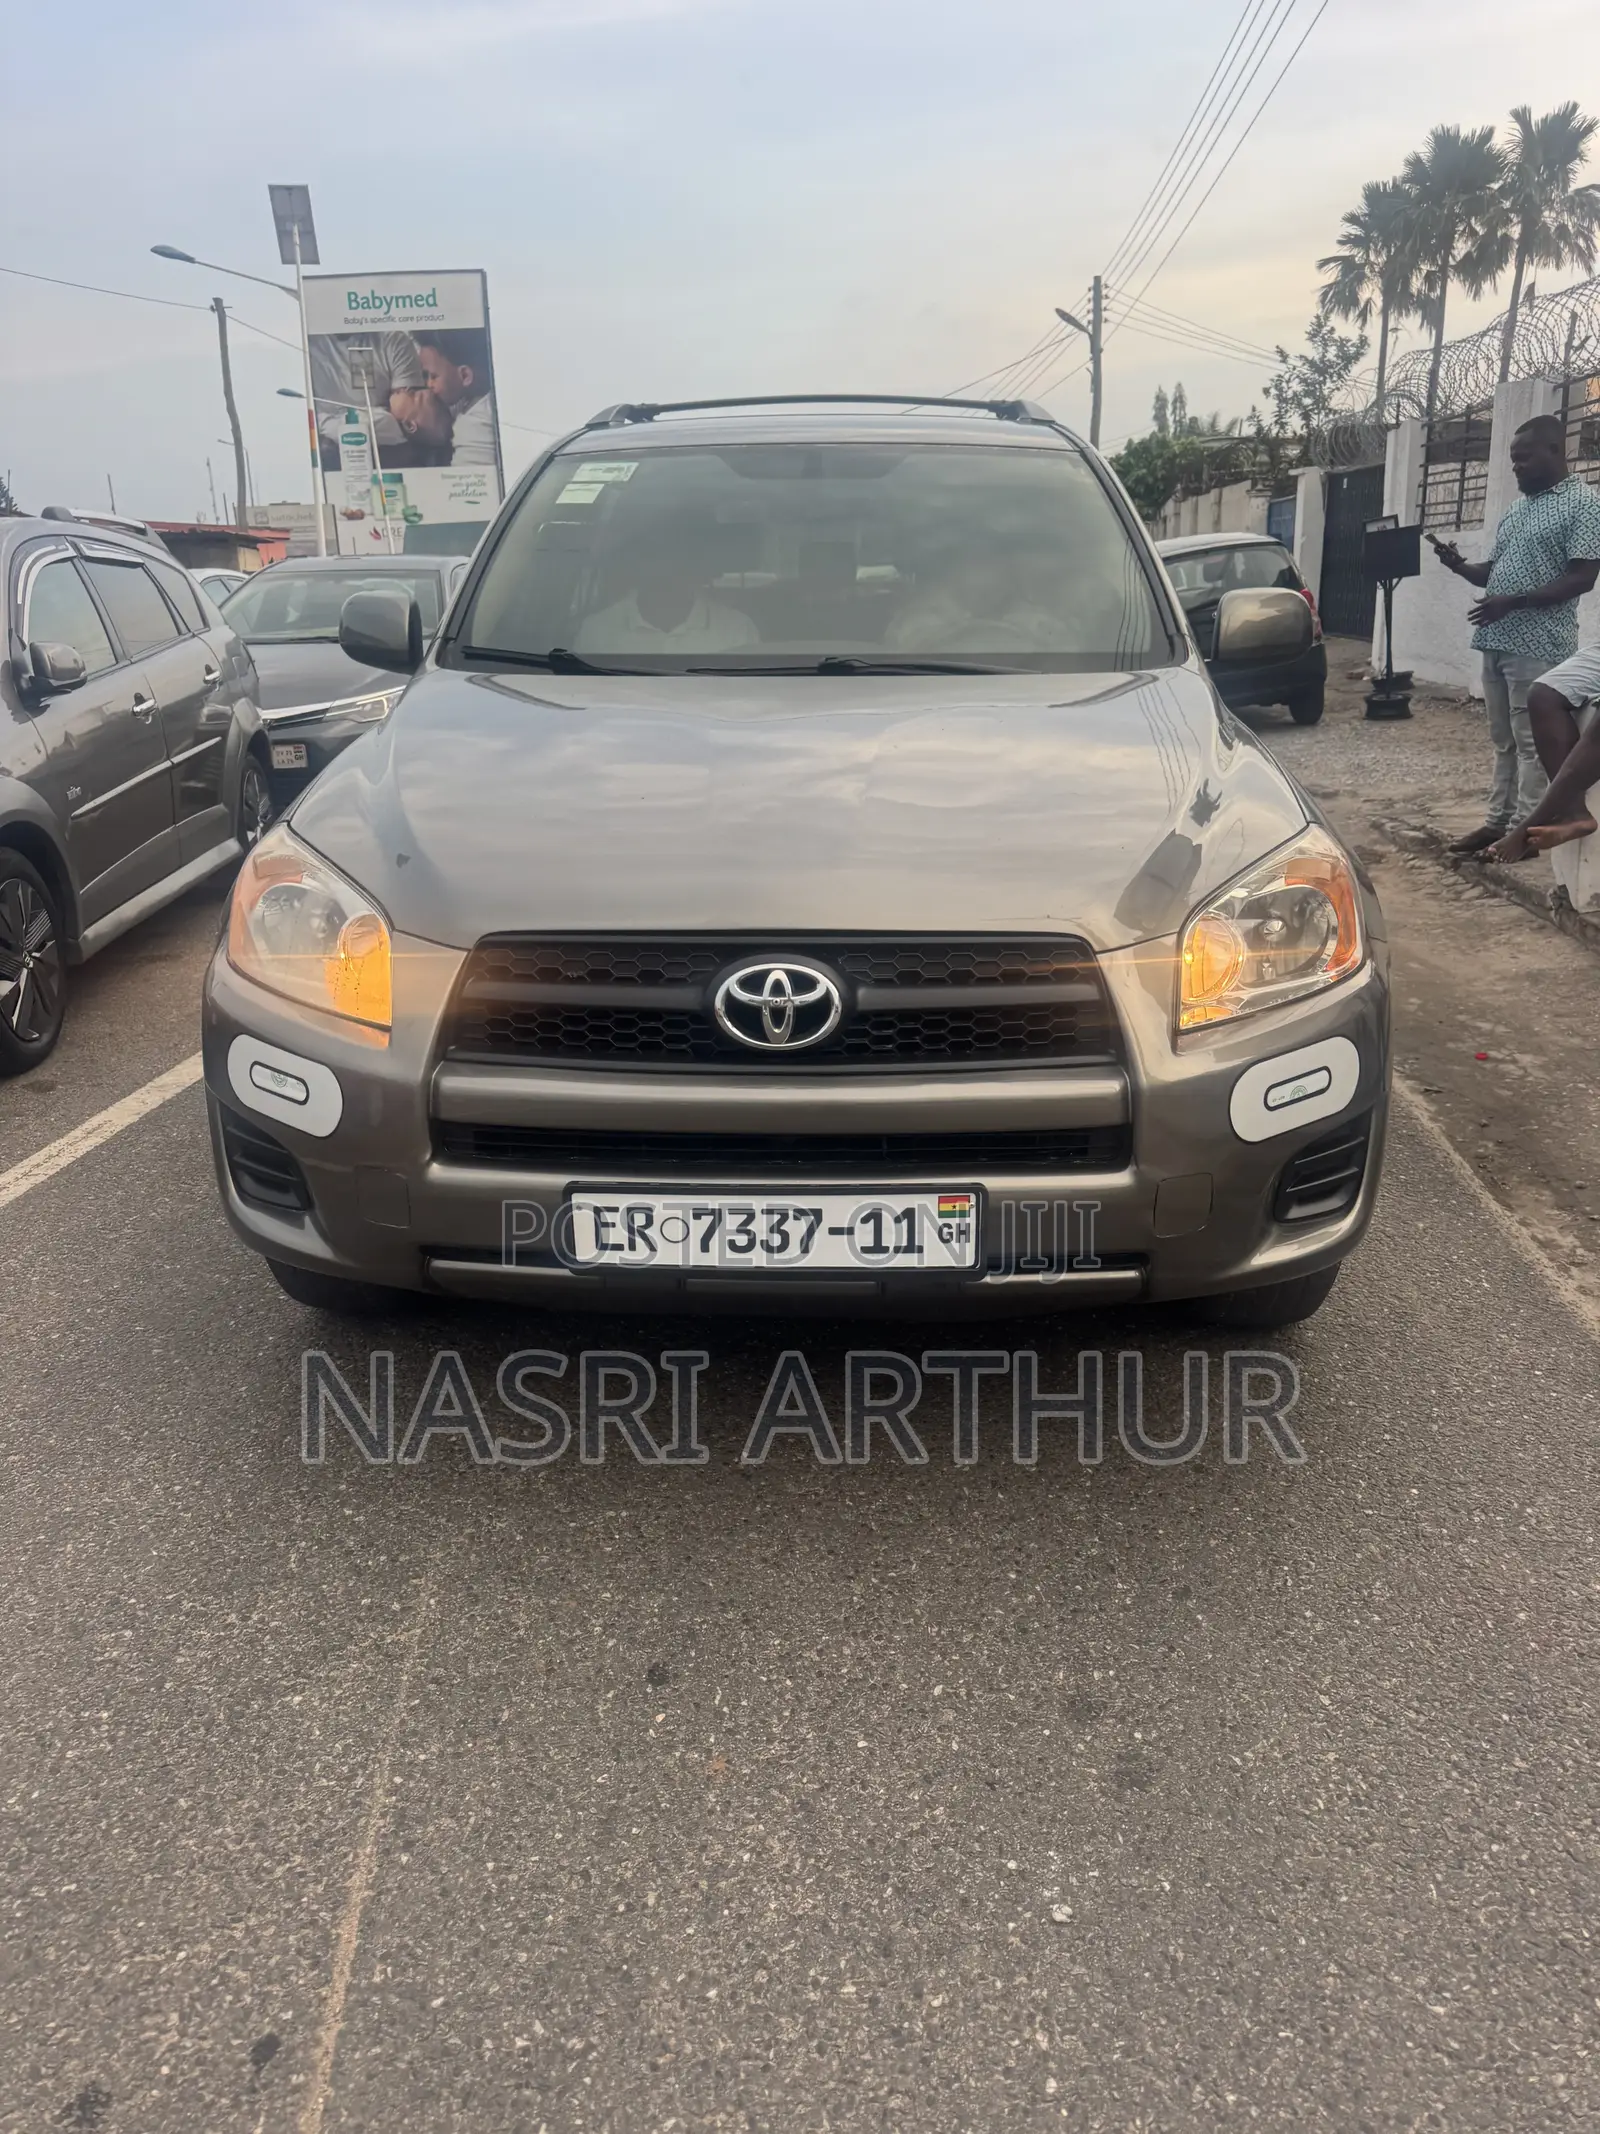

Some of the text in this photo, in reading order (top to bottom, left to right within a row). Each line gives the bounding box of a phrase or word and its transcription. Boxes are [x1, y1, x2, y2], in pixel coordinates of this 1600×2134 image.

[347, 287, 438, 315] Babymed
[343, 313, 445, 326] Baby's specific care product
[592, 1205, 924, 1255] ER 7337-11
[937, 1221, 972, 1245] GH
